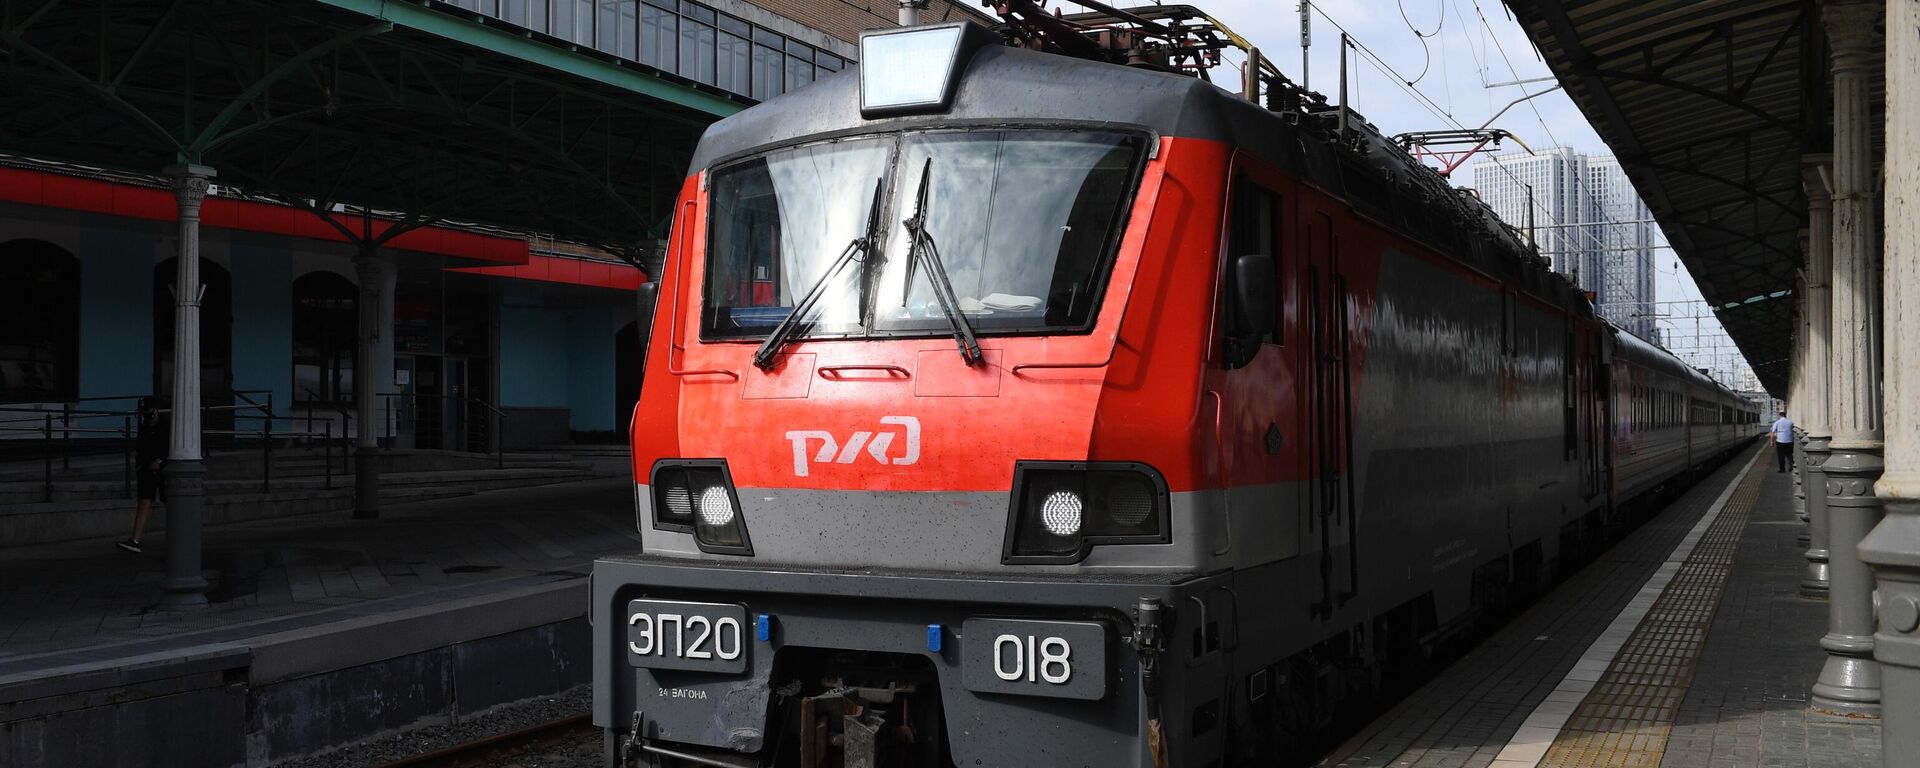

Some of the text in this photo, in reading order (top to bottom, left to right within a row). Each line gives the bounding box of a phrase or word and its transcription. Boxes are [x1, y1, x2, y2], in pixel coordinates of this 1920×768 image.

[629, 612, 741, 660] ЭП20
[994, 634, 1071, 684] 018
[658, 687, 707, 700] 24 ВАГОНА
